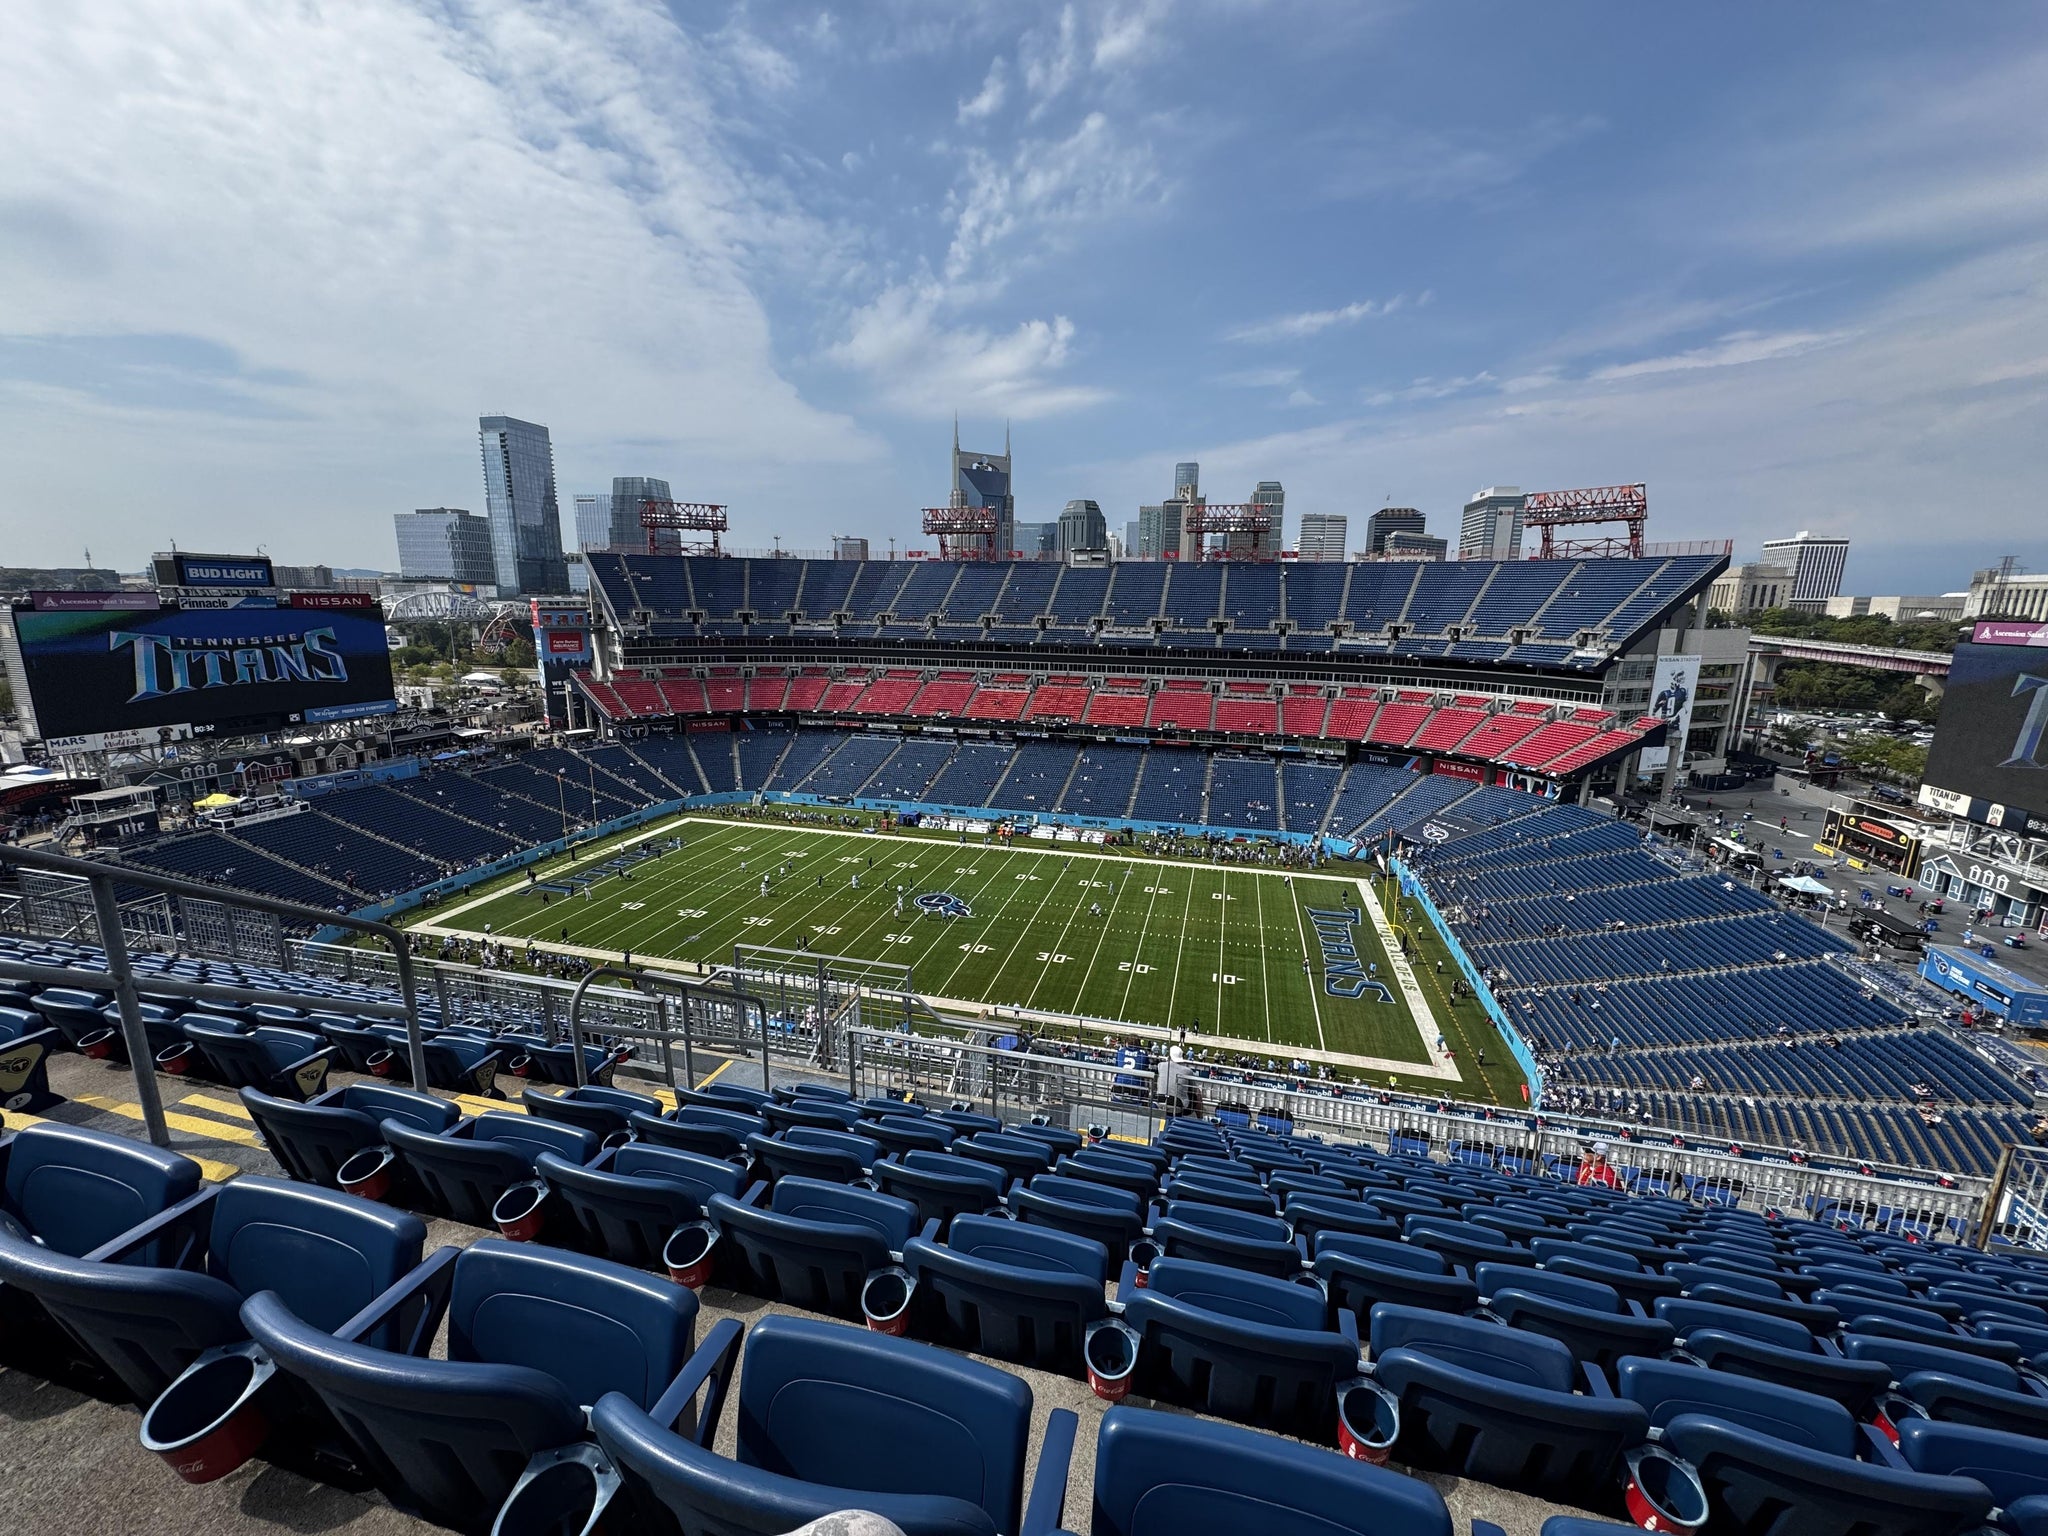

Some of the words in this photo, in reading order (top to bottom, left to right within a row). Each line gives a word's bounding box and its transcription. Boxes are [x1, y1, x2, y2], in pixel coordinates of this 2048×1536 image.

[188, 567, 220, 578] BUD
[223, 568, 263, 579] LIGHT
[181, 598, 229, 609] Pinnacle
[303, 597, 362, 606] NISSAN
[1993, 629, 2026, 638] Ascension
[177, 633, 297, 646] TENNESSEE
[110, 626, 348, 704] TITANS
[1667, 696, 1676, 716] 9
[50, 736, 86, 748] MARS
[1439, 762, 1479, 775] NISSAN
[1929, 787, 1951, 800] TITAN
[1950, 793, 1962, 803] UP
[1431, 818, 1469, 833] NISSAN
[1014, 873, 1039, 881] 40
[1078, 879, 1103, 888] 30
[1143, 886, 1169, 895] 20
[1211, 893, 1231, 901] 10
[680, 909, 708, 919] 20
[746, 916, 774, 926] 30
[812, 925, 843, 935] 40
[882, 933, 914, 944] 50
[958, 943, 989, 954] 40
[1035, 951, 1067, 963] 30
[1304, 905, 1397, 1004] TITANS
[1118, 962, 1150, 974] 20
[1396, 966, 1412, 977] OF
[1212, 973, 1236, 985] 10
[1401, 979, 1418, 992] US
[1123, 1057, 1136, 1070] 2
[1252, 1080, 1287, 1091] permobil
[14, 1096, 23, 1106] P
[1342, 1094, 1379, 1104] permobil
[1389, 1102, 1427, 1112] permobil
[1297, 1122, 1306, 1130] 12
[1097, 1385, 1125, 1394] Coca-Cola
